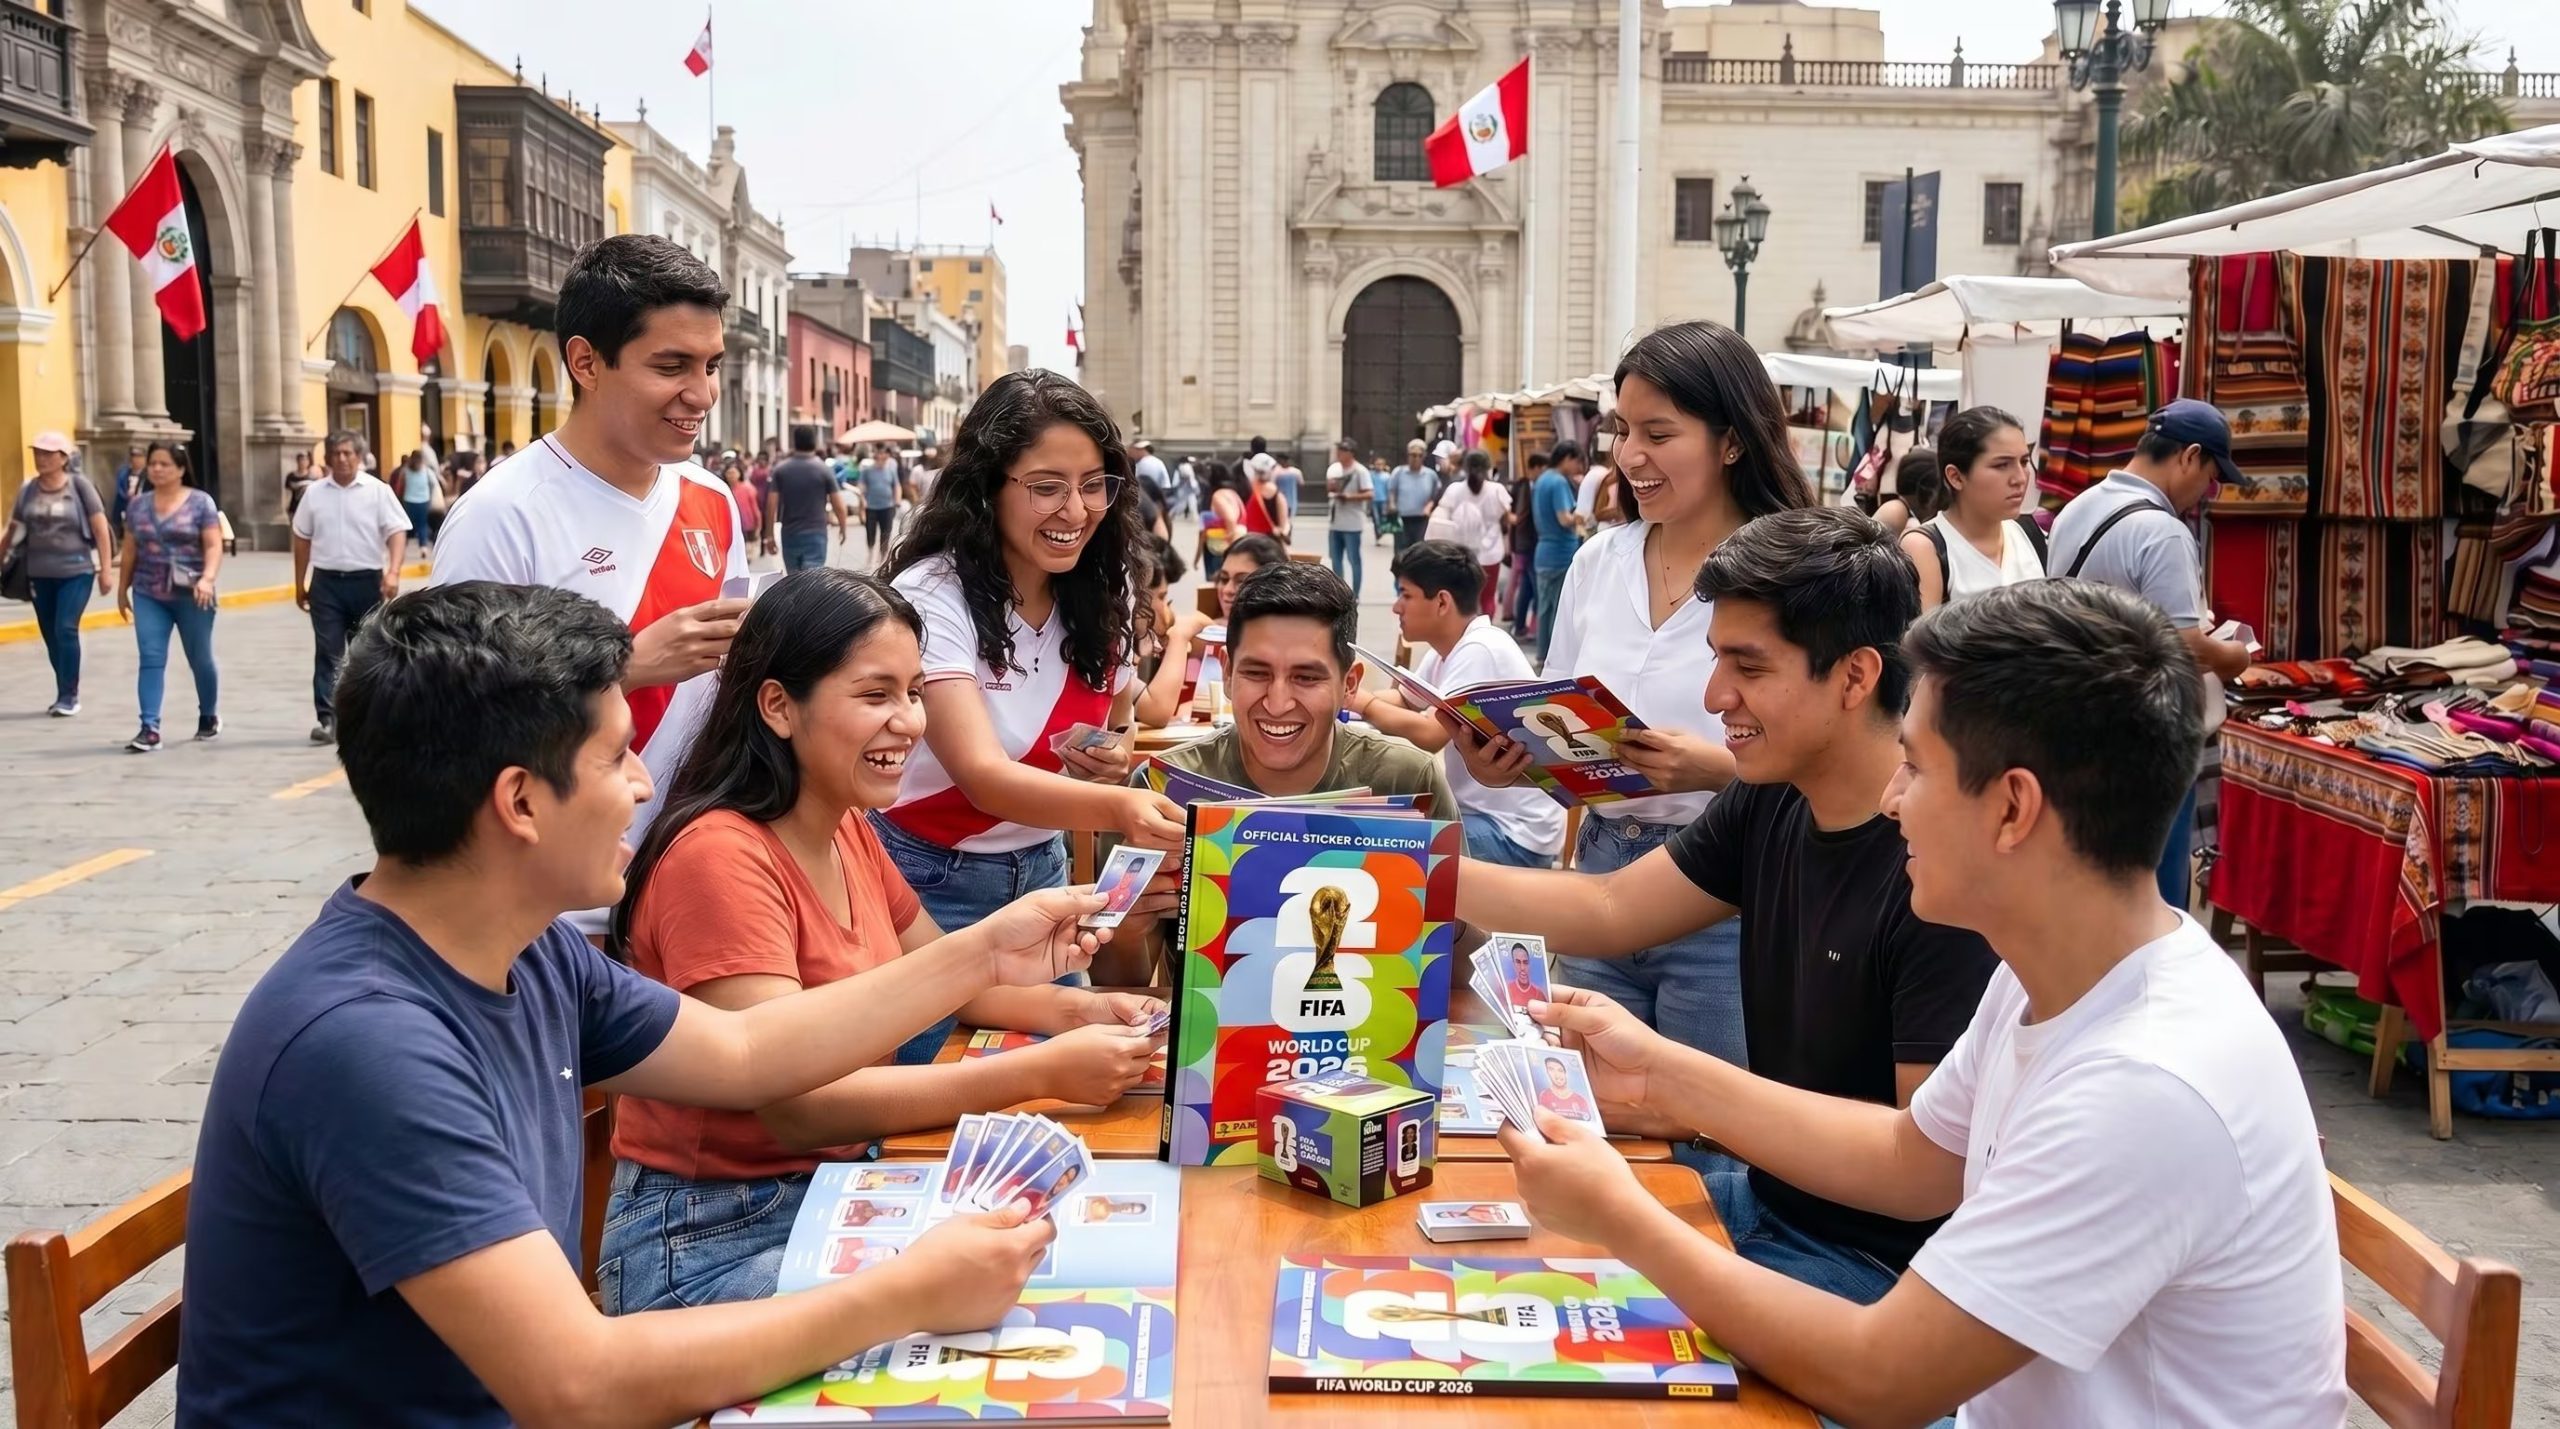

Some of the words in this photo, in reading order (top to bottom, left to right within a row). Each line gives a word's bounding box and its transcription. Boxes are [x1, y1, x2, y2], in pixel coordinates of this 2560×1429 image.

[1242, 829, 1300, 843] OFFICIAL
[1302, 833, 1352, 846] STICKER
[1354, 836, 1426, 849] COLLECTION
[1300, 1000, 1346, 1016] FIFA
[1267, 1038, 1334, 1055] WORLD
[1336, 1037, 1371, 1051] CUP
[1265, 1056, 1368, 1081] 2026
[1517, 1304, 1538, 1327] FIFA
[906, 1344, 930, 1368] FIFA
[1316, 1378, 1346, 1391] FIFA
[1349, 1379, 1402, 1392] WORLD
[1405, 1380, 1435, 1392] CUP
[1438, 1381, 1473, 1393] 2026
